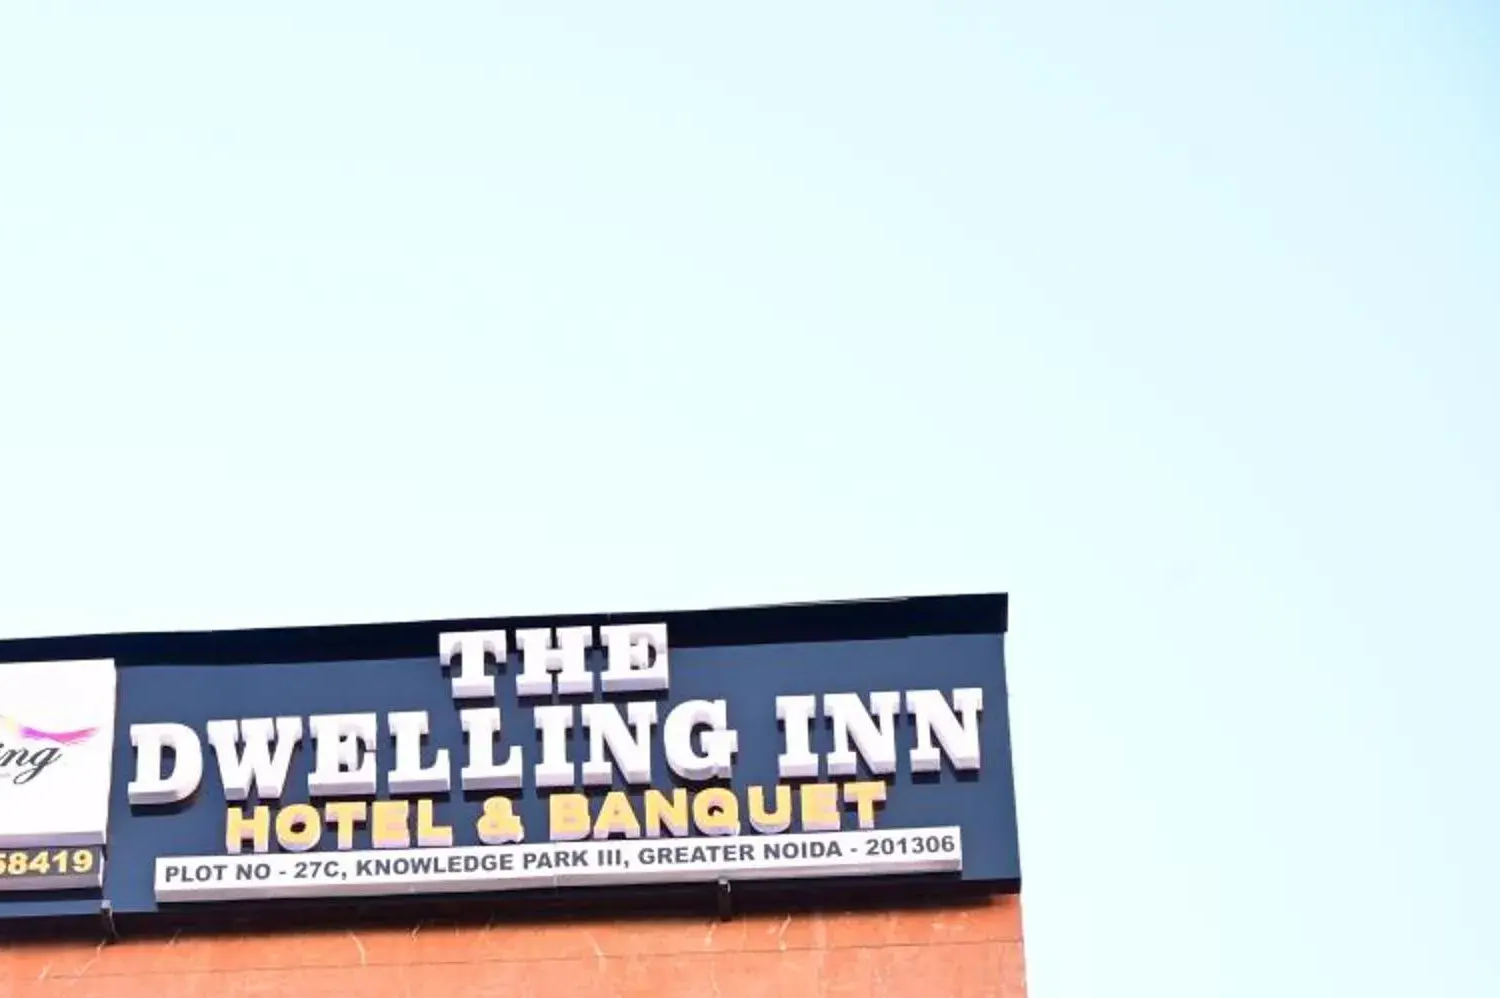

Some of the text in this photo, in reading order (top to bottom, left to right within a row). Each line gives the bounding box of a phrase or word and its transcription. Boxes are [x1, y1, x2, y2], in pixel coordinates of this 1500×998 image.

[439, 622, 669, 698] THE
[128, 687, 983, 805] DWELLING INN
[225, 781, 887, 853] HOTEL & BANQUET
[165, 865, 228, 883] PLOT
[235, 863, 271, 881] NO
[294, 860, 347, 881] 27C,
[356, 853, 514, 877] KNOWLEDGE
[523, 849, 589, 870] PARK
[597, 849, 631, 868] III,
[638, 842, 756, 866] GREATER
[763, 840, 843, 861] NOIDA
[865, 835, 956, 857] 201306
